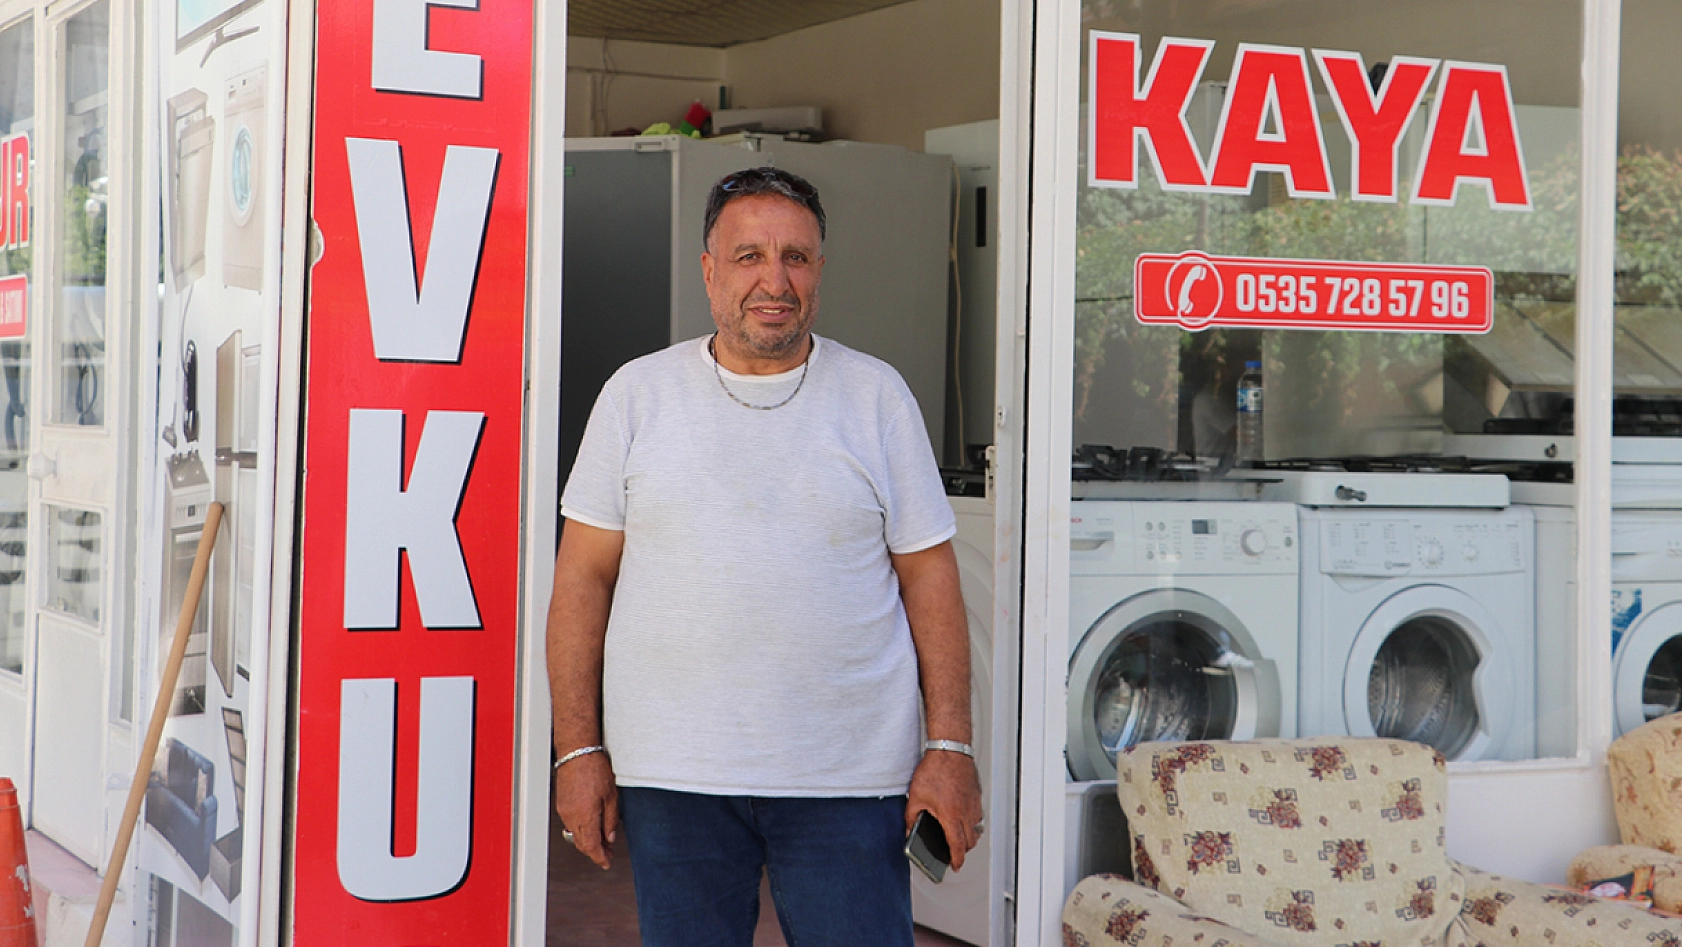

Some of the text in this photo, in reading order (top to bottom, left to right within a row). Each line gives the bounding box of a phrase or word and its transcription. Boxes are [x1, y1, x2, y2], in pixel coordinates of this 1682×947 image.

[1088, 29, 1534, 211] KAYA
[1236, 273, 1469, 318] 0535 728 57 96
